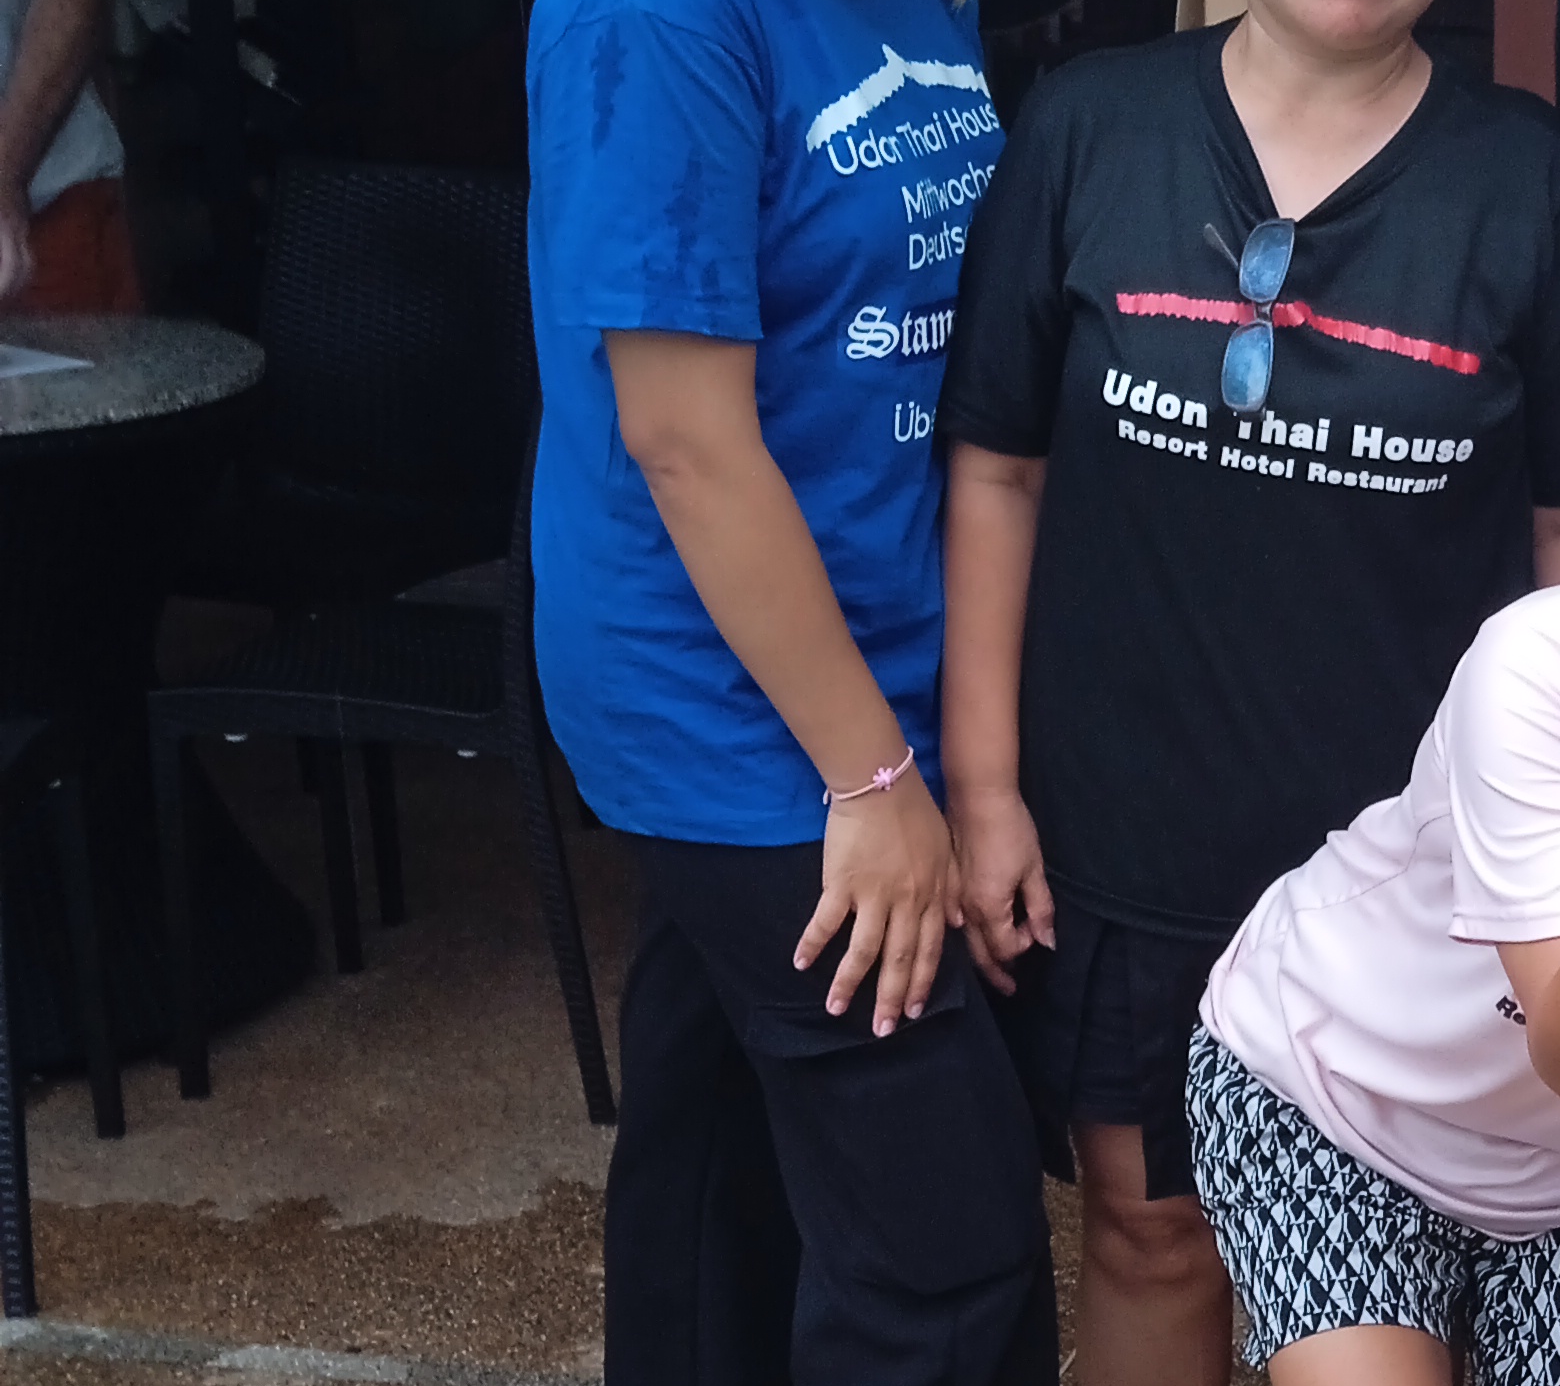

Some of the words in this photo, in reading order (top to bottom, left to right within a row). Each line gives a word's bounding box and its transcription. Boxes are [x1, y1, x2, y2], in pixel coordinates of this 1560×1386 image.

[896, 112, 947, 157] Thai
[943, 103, 1000, 144] Hous
[908, 219, 969, 271] Deuts
[1102, 368, 1207, 428] Udon
[1351, 424, 1473, 463] House
[1118, 419, 1208, 460] Resort
[1220, 445, 1294, 479] Hotel
[1307, 462, 1447, 494] Restaurant
